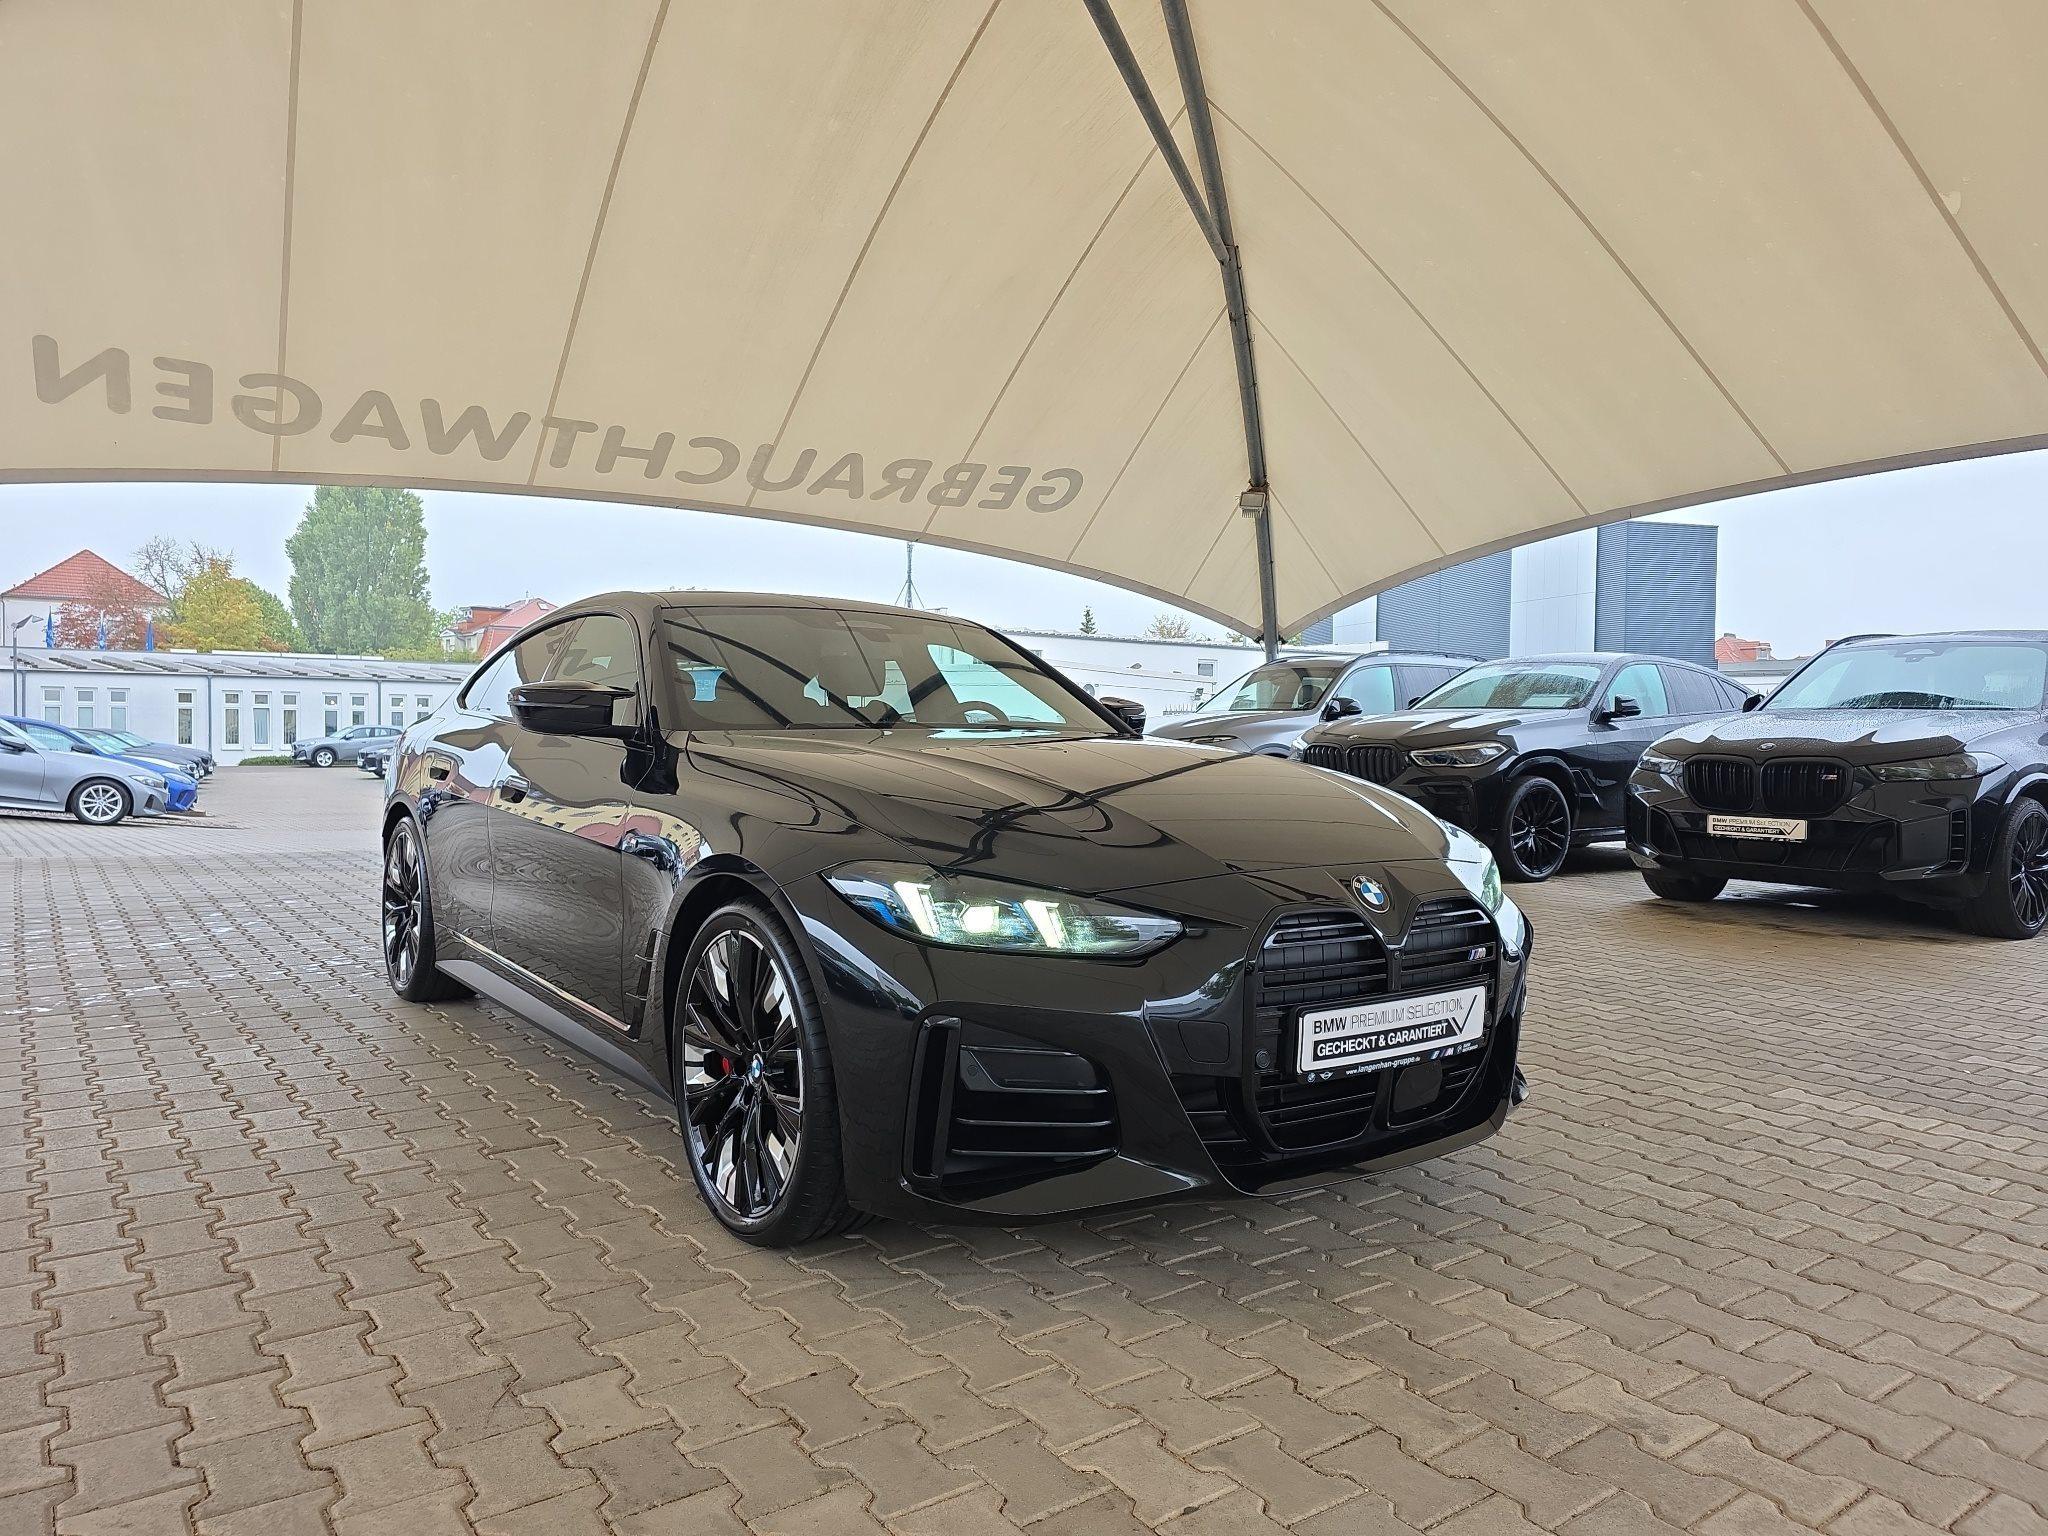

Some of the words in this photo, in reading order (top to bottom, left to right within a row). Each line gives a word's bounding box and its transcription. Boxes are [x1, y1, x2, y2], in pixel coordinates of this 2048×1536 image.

[1728, 818, 1756, 826] PREMIUM
[1745, 826, 1780, 834] GARANTIERT
[1313, 1016, 1347, 1035] BMW
[1351, 1007, 1405, 1029] PREMIUM
[1317, 1035, 1377, 1057] GECHECKT
[1379, 1034, 1386, 1047] &
[1387, 1022, 1449, 1044] GARANTIERT
[1345, 1056, 1421, 1076] www.langenhan-gruppe.de
